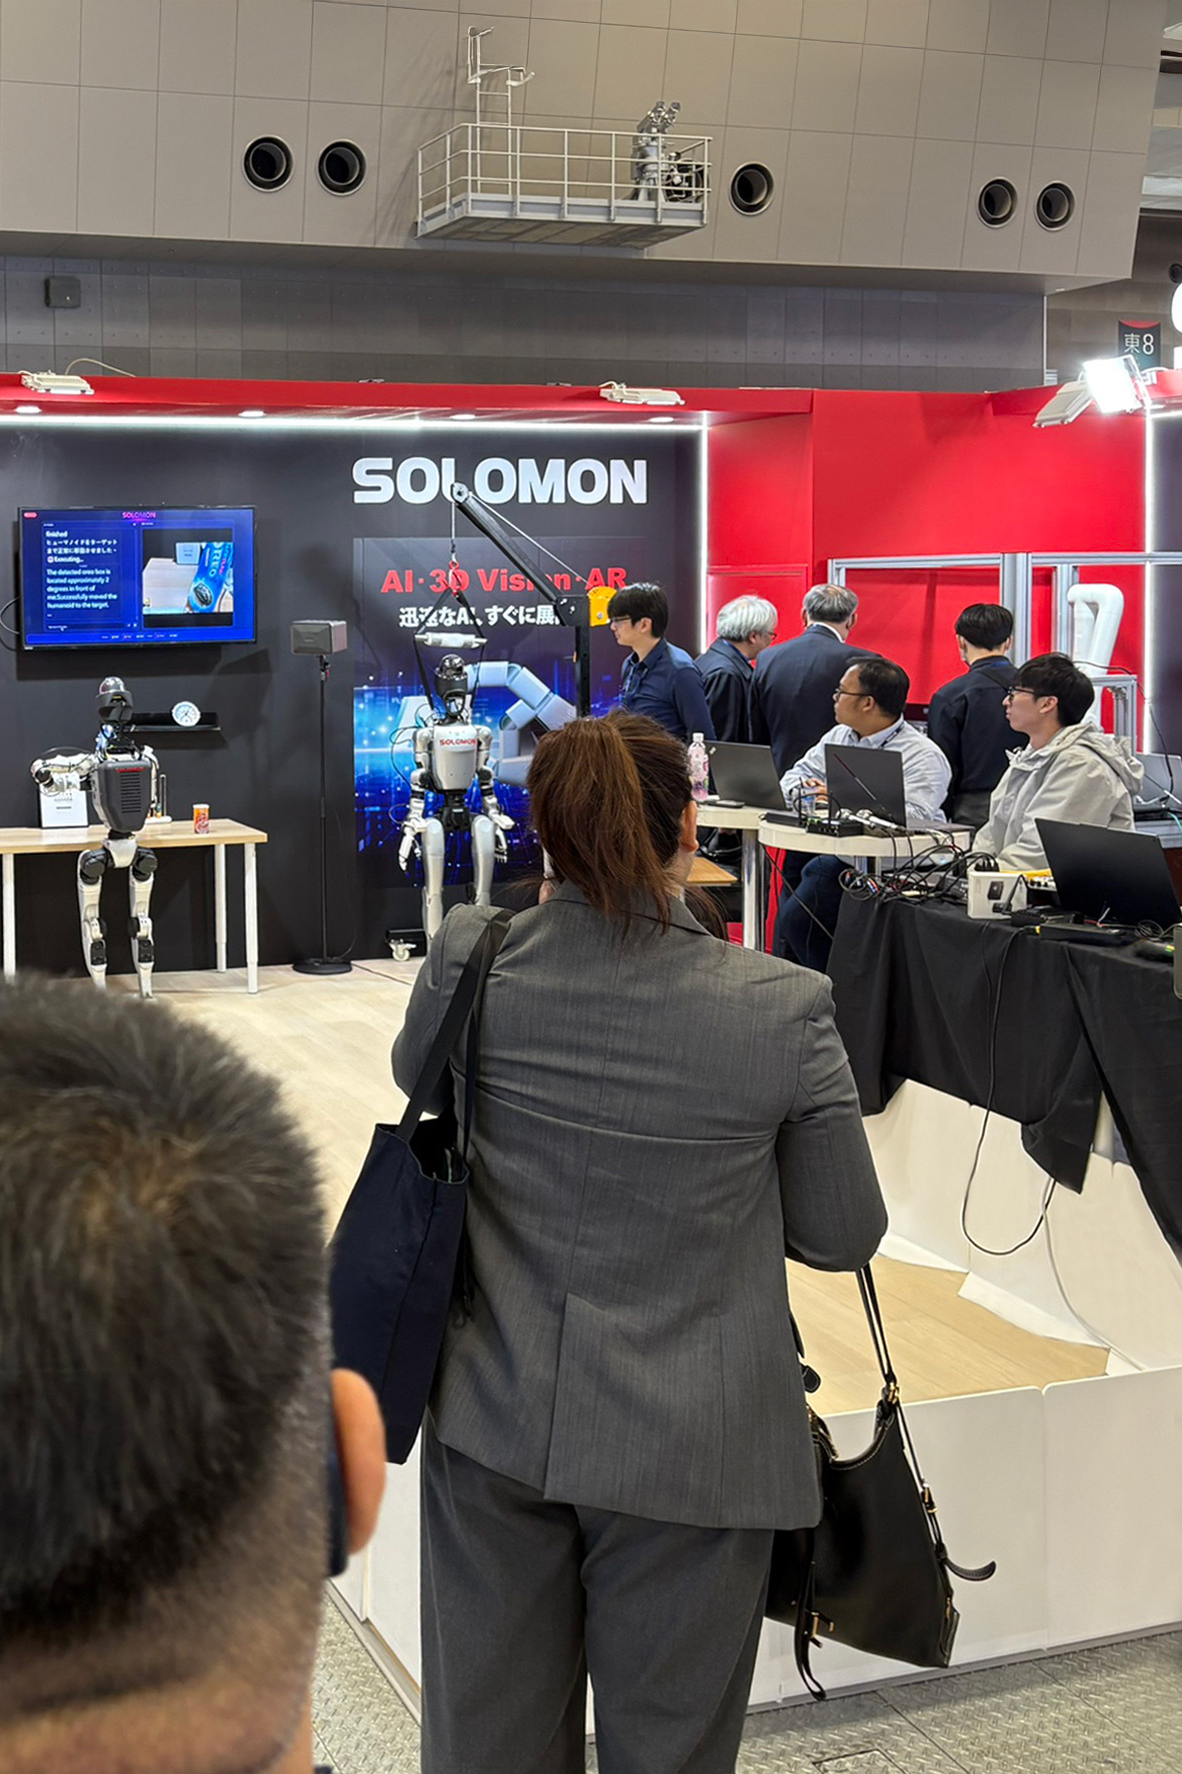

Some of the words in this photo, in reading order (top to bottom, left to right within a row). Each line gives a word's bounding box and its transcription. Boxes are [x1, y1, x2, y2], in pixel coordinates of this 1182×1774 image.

[1124, 333, 1154, 355] 東8
[352, 457, 648, 504] SOLOMON
[122, 511, 157, 519] SOLOMON
[399, 605, 561, 627] 迅速なAI、すぐに展
